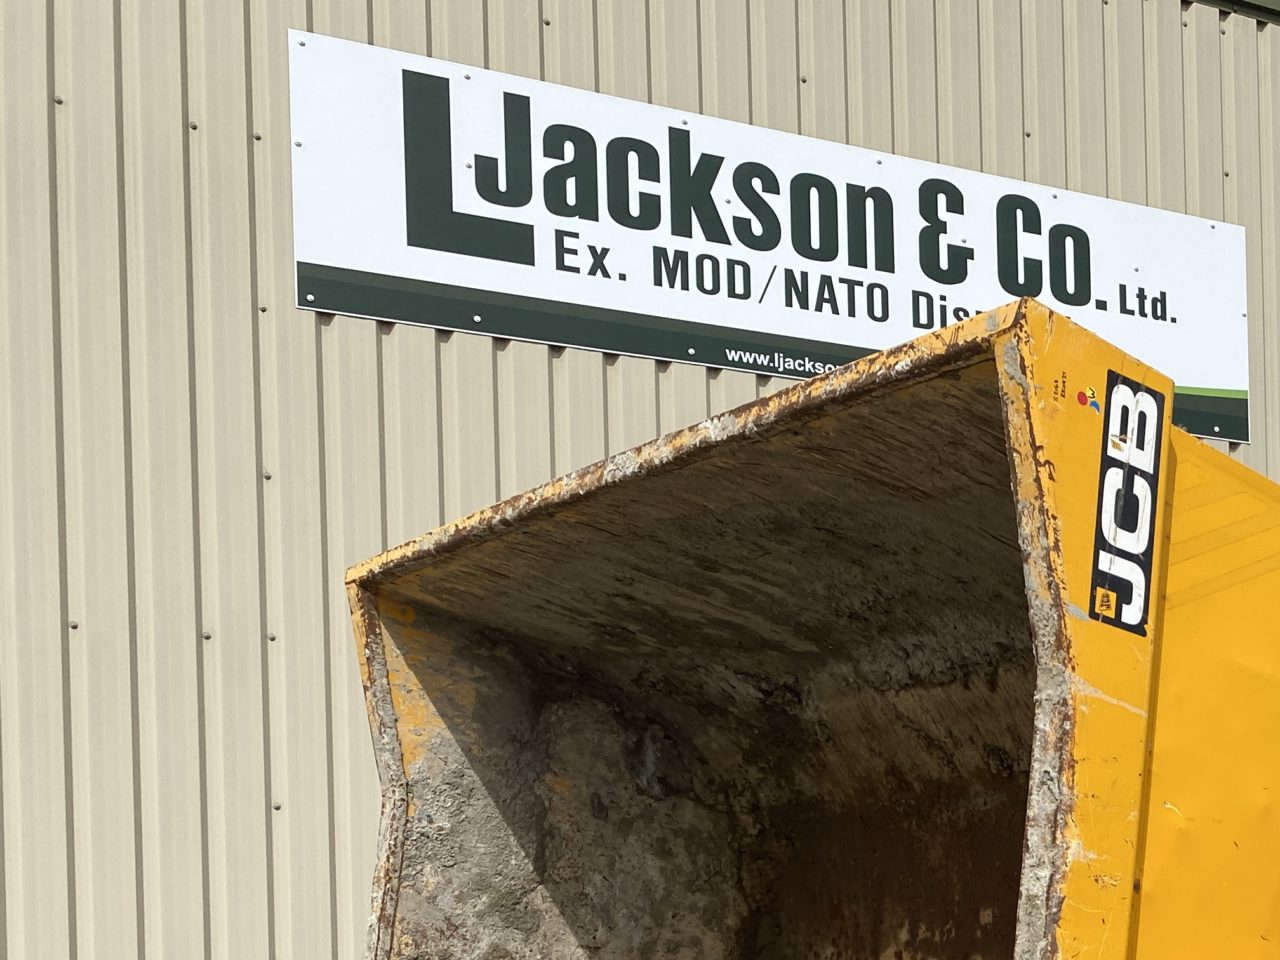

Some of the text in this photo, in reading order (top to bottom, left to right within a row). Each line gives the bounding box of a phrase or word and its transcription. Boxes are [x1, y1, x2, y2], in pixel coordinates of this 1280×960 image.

[555, 229, 627, 281] Ex.
[652, 246, 889, 323] MOD/NATO
[918, 178, 974, 285] &
[996, 194, 1107, 311] Co.
[1118, 284, 1177, 324] Ltd.
[725, 348, 842, 374] www.ljackso
[1098, 384, 1158, 626] JCB
